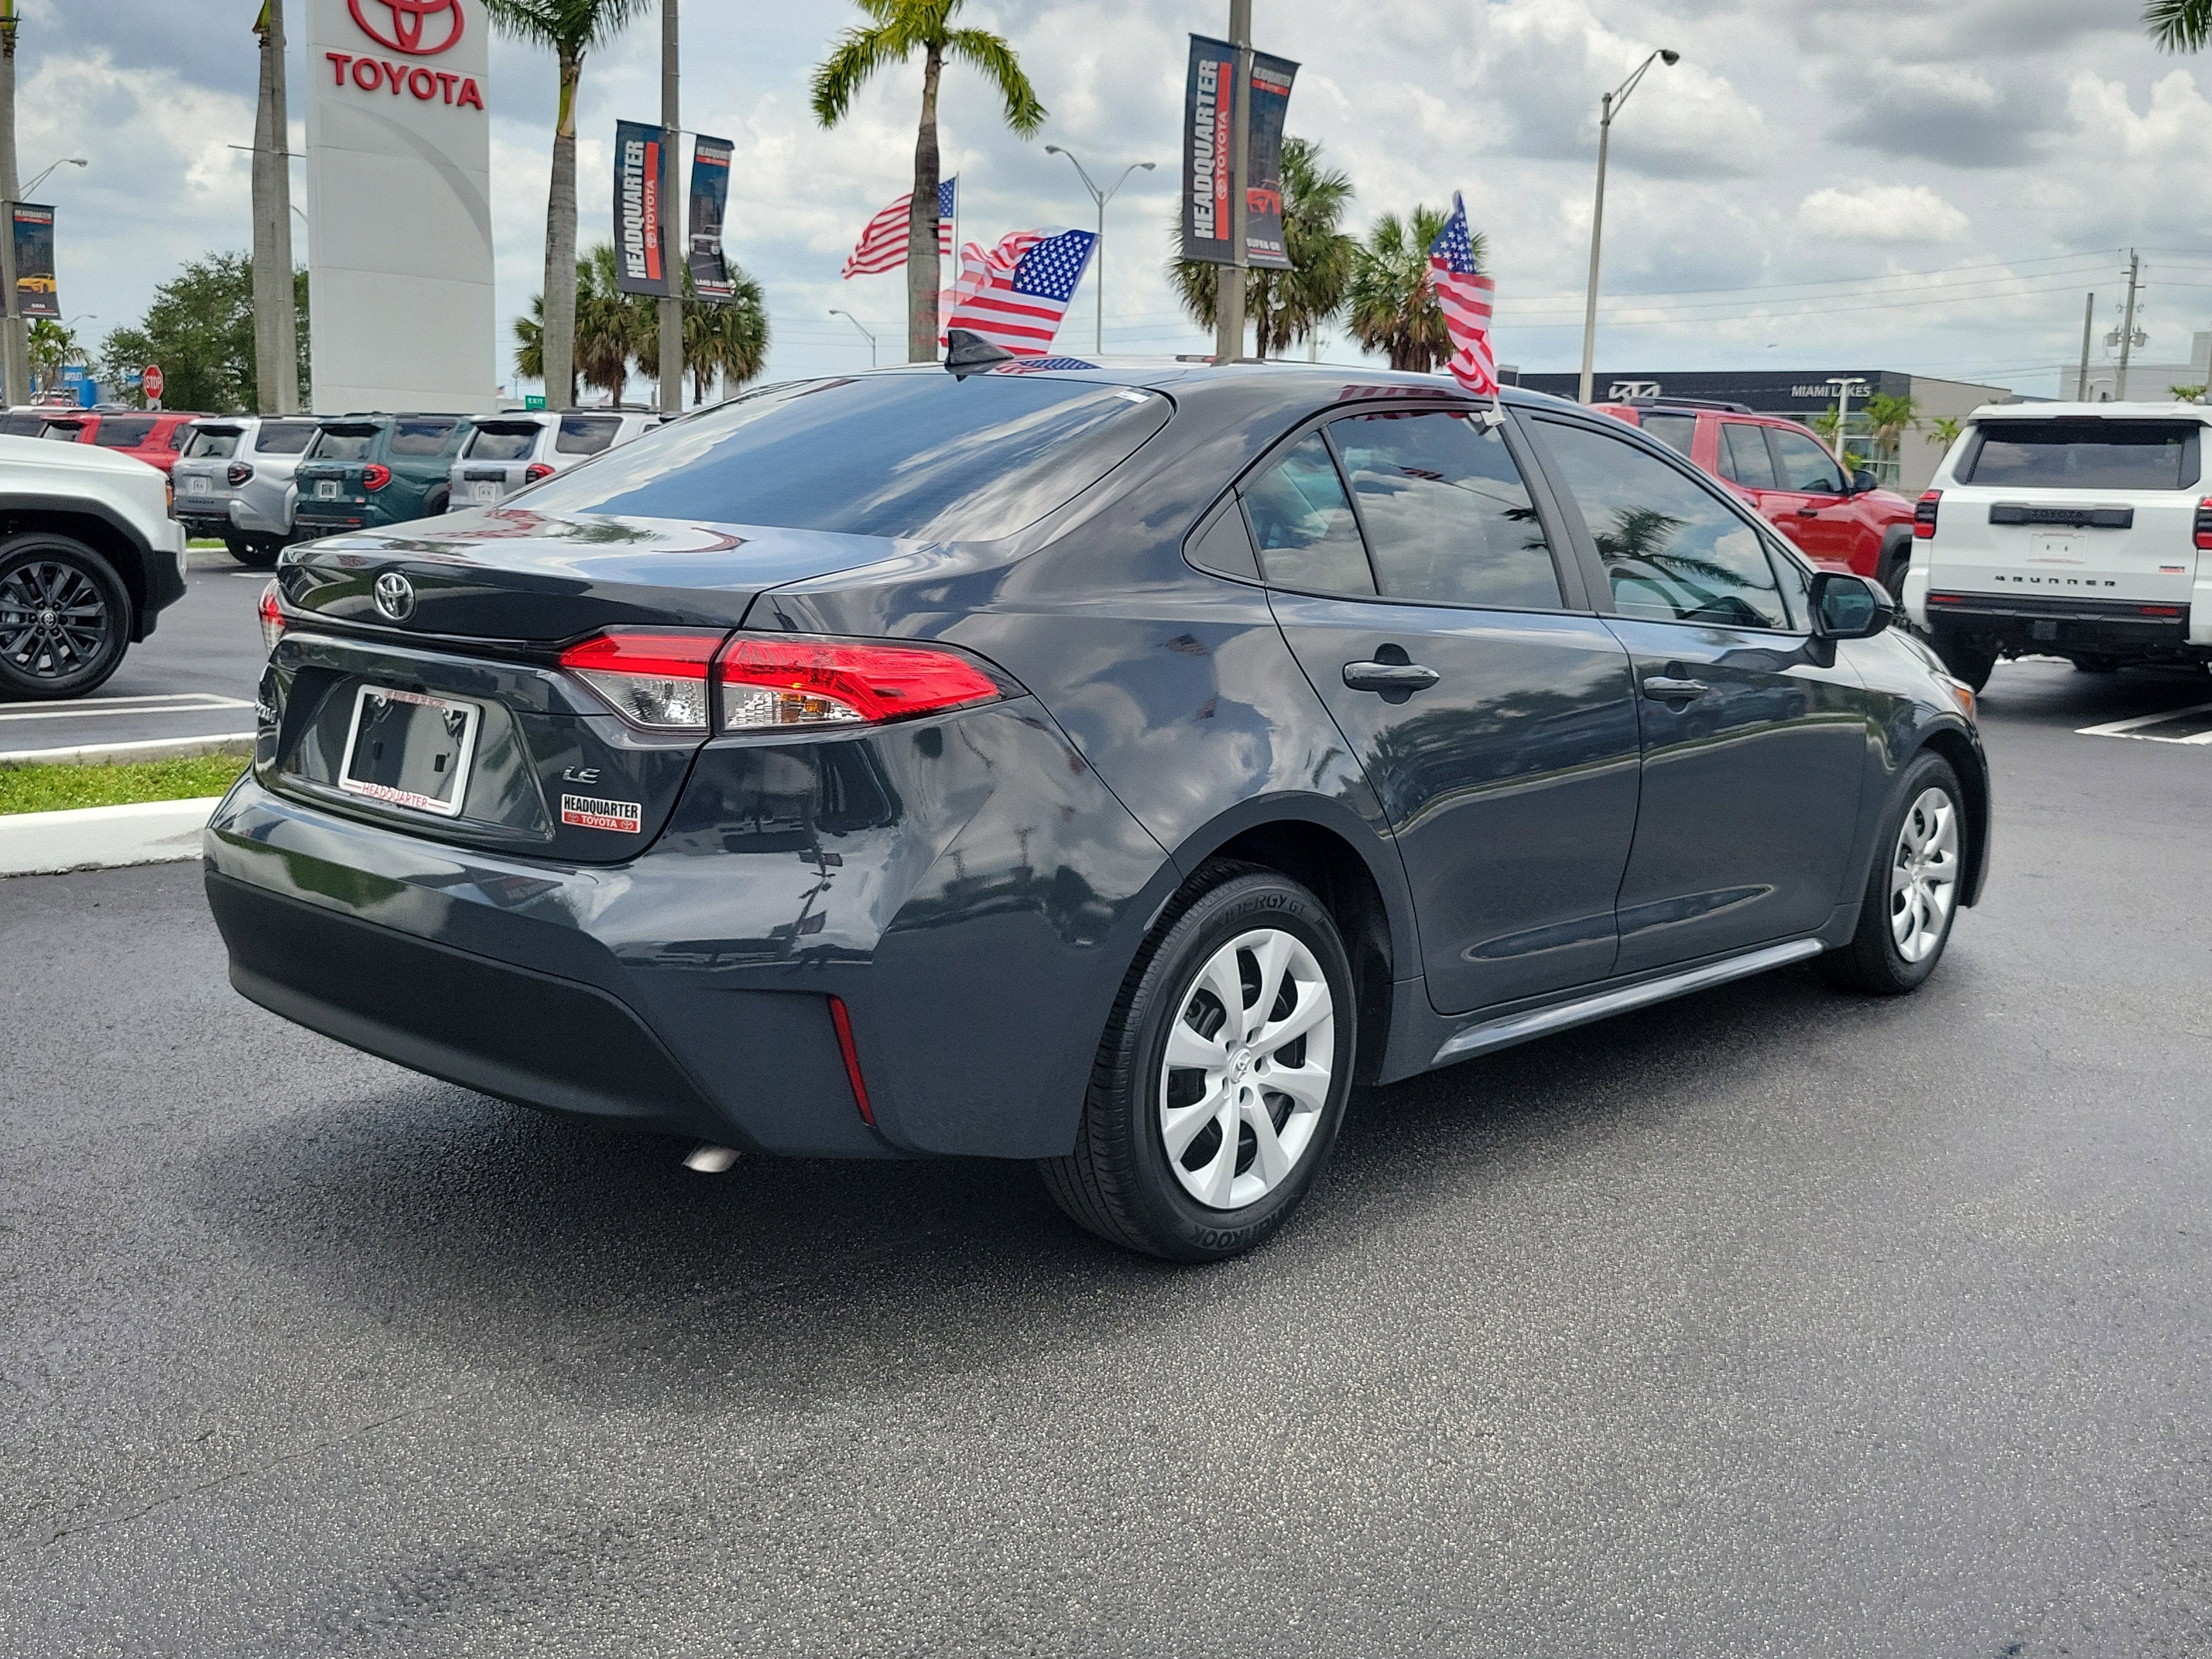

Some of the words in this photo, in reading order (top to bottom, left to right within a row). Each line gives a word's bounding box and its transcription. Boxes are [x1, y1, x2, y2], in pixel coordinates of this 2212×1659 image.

[326, 52, 484, 110] TOYOTA
[1193, 59, 1218, 239] HEADQUARTER
[1216, 111, 1228, 175] TOYOTA
[622, 140, 647, 279] HEADQUARTER
[645, 180, 656, 231] TOYOTA
[146, 376, 162, 389] STOP
[1609, 383, 1660, 399] KIA
[1791, 385, 1828, 397] MIAMI
[563, 766, 601, 784] LE
[363, 782, 428, 808] HEADQUARTER
[564, 795, 638, 819] HEADQUARTER
[581, 815, 618, 828] TOYOTA
